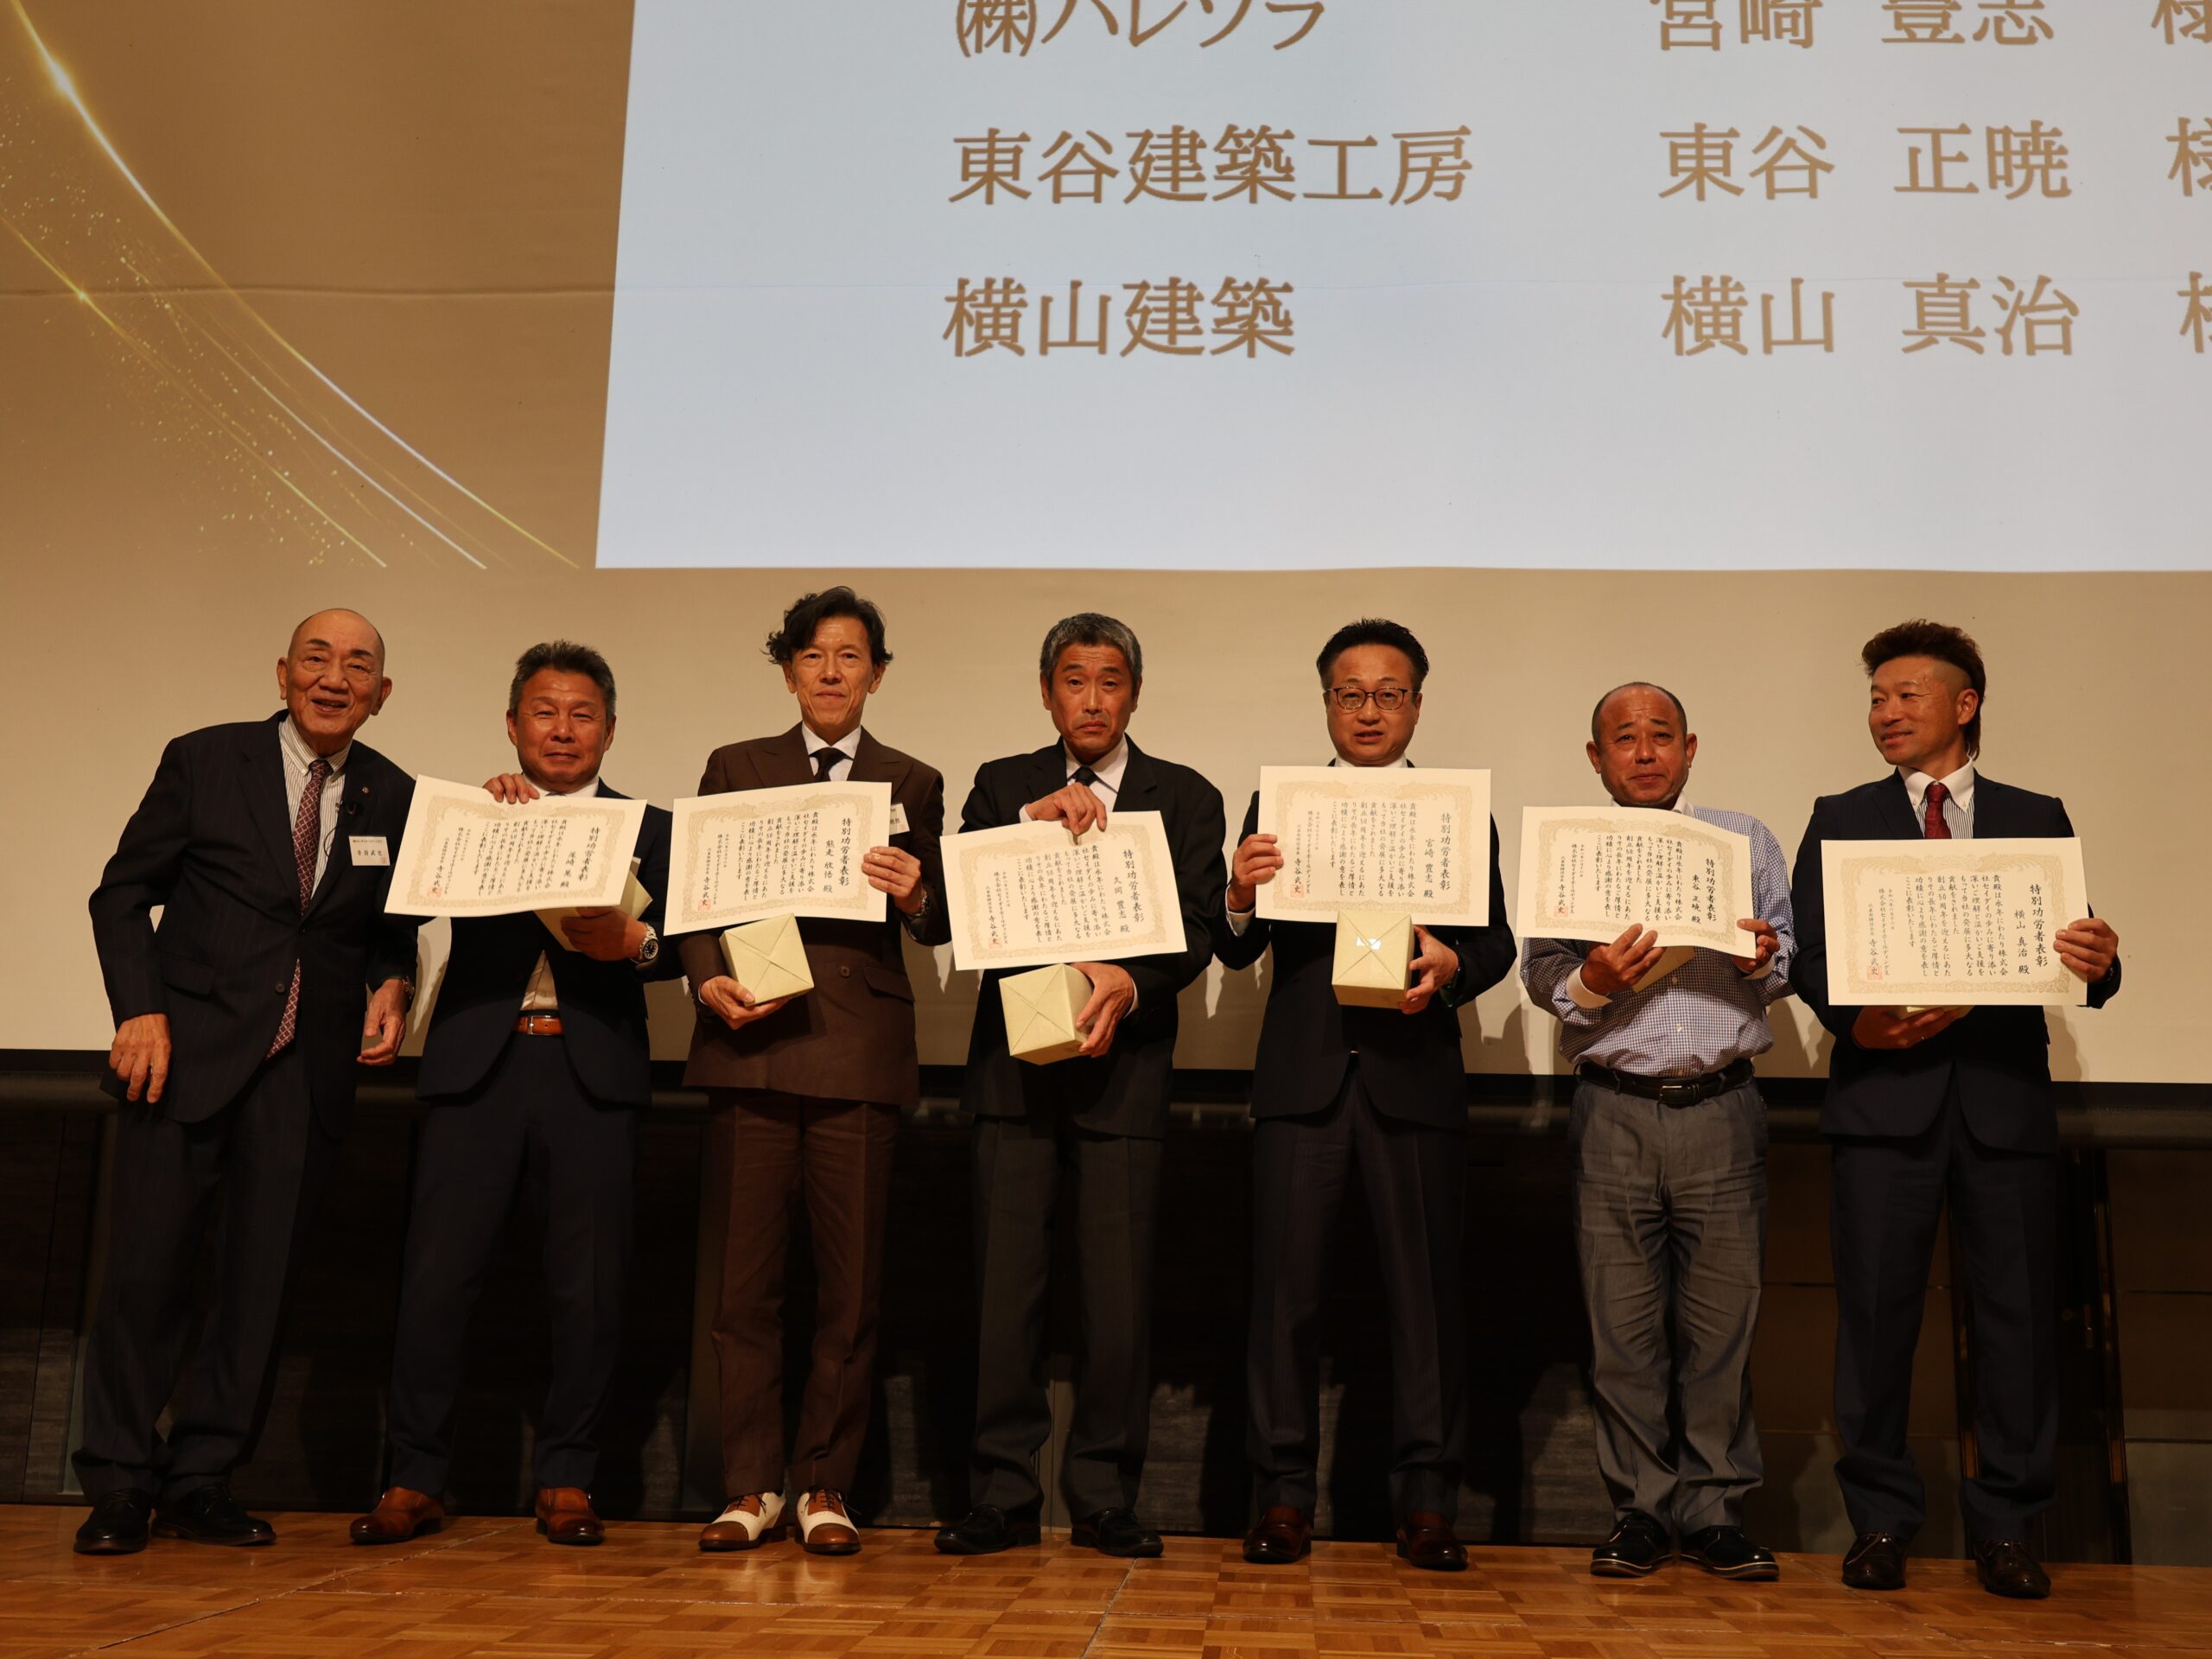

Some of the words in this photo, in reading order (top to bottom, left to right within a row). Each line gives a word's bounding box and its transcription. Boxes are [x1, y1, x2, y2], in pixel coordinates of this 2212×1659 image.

[948, 124, 1472, 206] 東谷建築工房
[1658, 122, 1835, 201] 東谷
[1893, 119, 2072, 200] 正暁
[943, 276, 1295, 358] 横山建築
[1661, 275, 1835, 356] 横山
[1901, 272, 2080, 356] 真治
[839, 817, 851, 886] 特別功労者表彰
[1123, 849, 1145, 922] 特別功労者表彰
[1440, 812, 1451, 890] 特別功労者表彰
[1692, 915, 1700, 924] 殿
[1706, 858, 1717, 921] 特別功労者表彰
[1906, 877, 1915, 947] ここに表彰いたします
[1949, 875, 1960, 934] 貢献をされました
[1961, 874, 1974, 976] もって当社の発展に多大なる
[1971, 875, 1984, 976] 深いご理解と温かいご支援を
[1993, 874, 2008, 975] 貴殿は永年にわたり株式会
[2014, 909, 2025, 929] 横山
[2030, 884, 2048, 967] 特別功労者表彰
[2018, 937, 2027, 957] 真治
[2018, 965, 2030, 974] 殿
